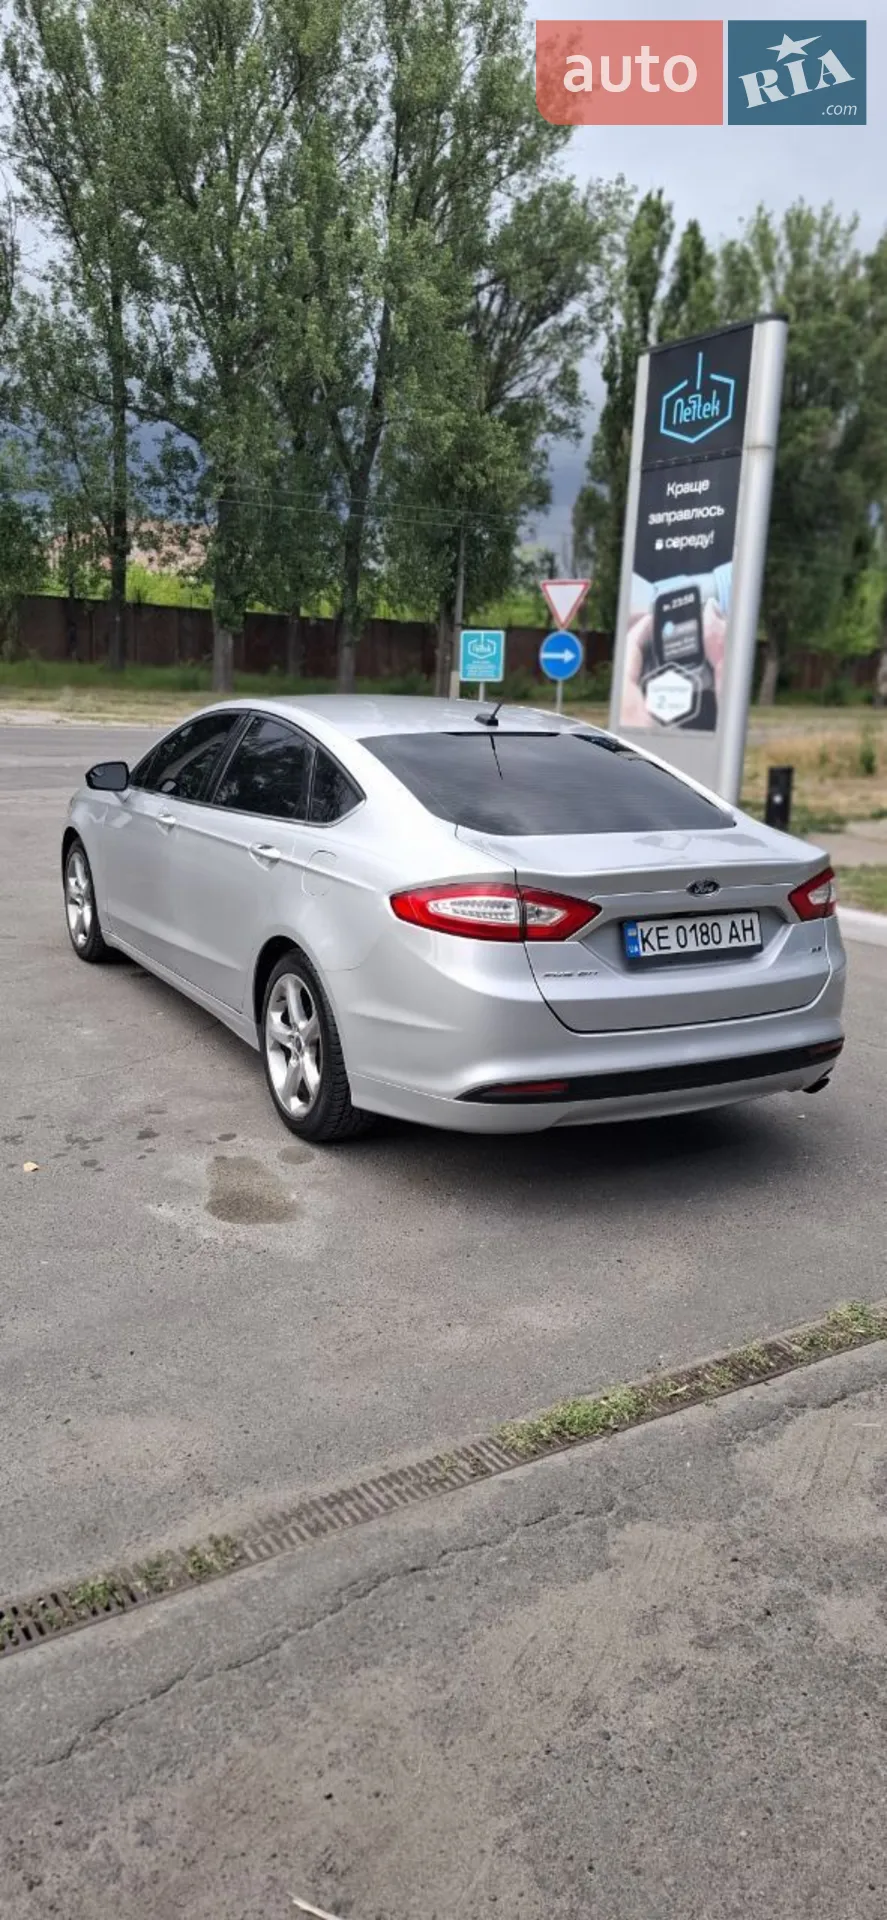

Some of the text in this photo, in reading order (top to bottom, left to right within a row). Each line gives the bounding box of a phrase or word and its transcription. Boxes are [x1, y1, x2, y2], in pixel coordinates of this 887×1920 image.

[666, 479, 710, 499] Краще
[648, 505, 725, 526] заправлюсь
[665, 529, 715, 551] середу!
[639, 918, 756, 952] KE 0180 AH
